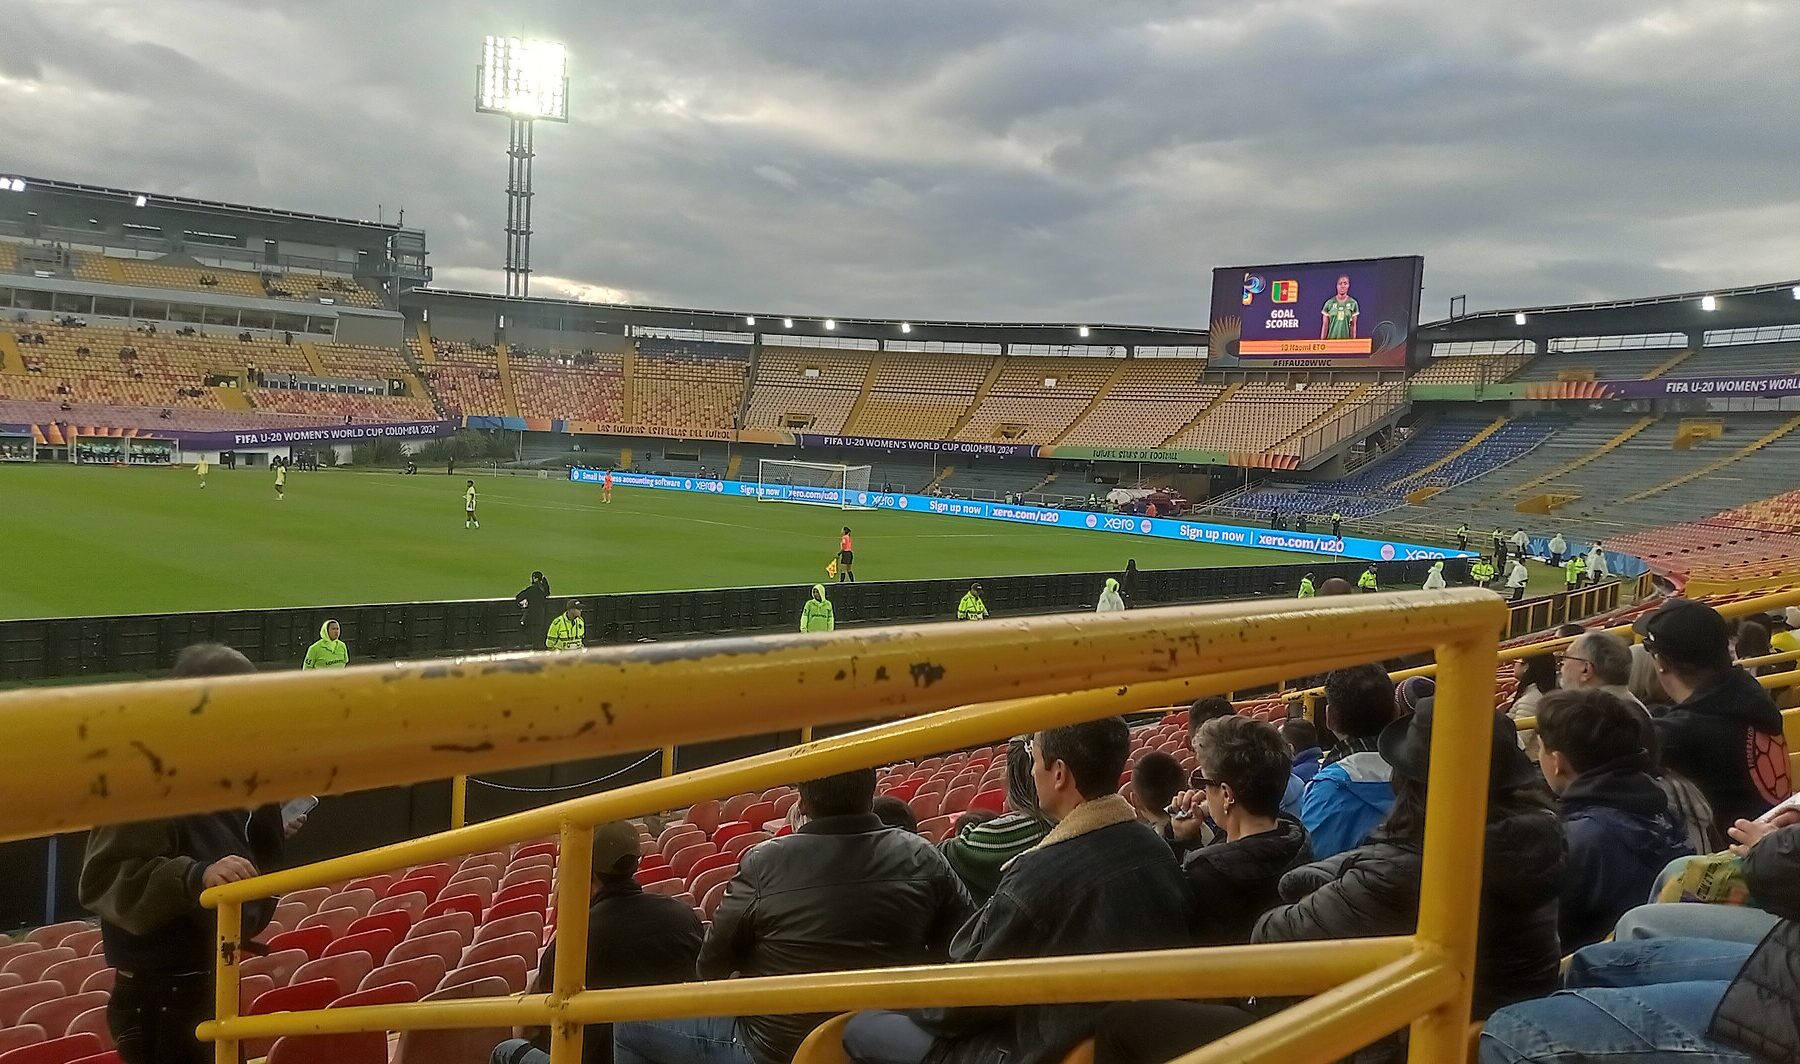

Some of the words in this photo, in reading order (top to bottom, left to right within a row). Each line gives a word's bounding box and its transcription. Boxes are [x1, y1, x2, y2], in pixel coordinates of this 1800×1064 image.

[1271, 309, 1295, 319] GOAL
[1265, 319, 1299, 329] SCORER
[1280, 343, 1289, 351] 10
[1312, 343, 1326, 351] ETO
[1272, 359, 1332, 367] #FIFAU20WWC
[1665, 382, 1689, 393] FIFA
[1691, 381, 1714, 393] U-20
[1716, 379, 1768, 392] WOMEN'S
[1769, 377, 1800, 390] WORL
[235, 434, 259, 444] FIFA
[260, 432, 282, 443] U-20
[283, 430, 329, 441] WOMEN'S
[331, 428, 364, 439] WORLD
[366, 427, 383, 437] CUP
[385, 425, 419, 436] COLOMBIA
[597, 423, 611, 433] LAS
[689, 428, 702, 438] DEL
[824, 437, 843, 446] FIFA
[845, 438, 865, 447] U-20
[865, 439, 907, 449] WOMEN'S
[908, 441, 940, 450] WORLD
[941, 442, 960, 452] CUP
[960, 443, 996, 454] COLOMBIA
[582, 471, 598, 481] Small
[622, 476, 654, 487] accounting
[654, 477, 681, 487] software
[740, 484, 755, 496] Sign
[765, 488, 781, 496] now
[788, 488, 839, 501] xero.com/u20
[871, 494, 895, 507] xero
[929, 500, 949, 513] Sign
[950, 504, 961, 514] up
[963, 505, 982, 515] now
[992, 507, 1060, 523] xero.com/u20
[1103, 516, 1135, 531] xero
[1179, 524, 1203, 540] Sign
[1205, 529, 1220, 542] up
[1221, 531, 1245, 542] now
[1258, 533, 1345, 553] xero.com/u20
